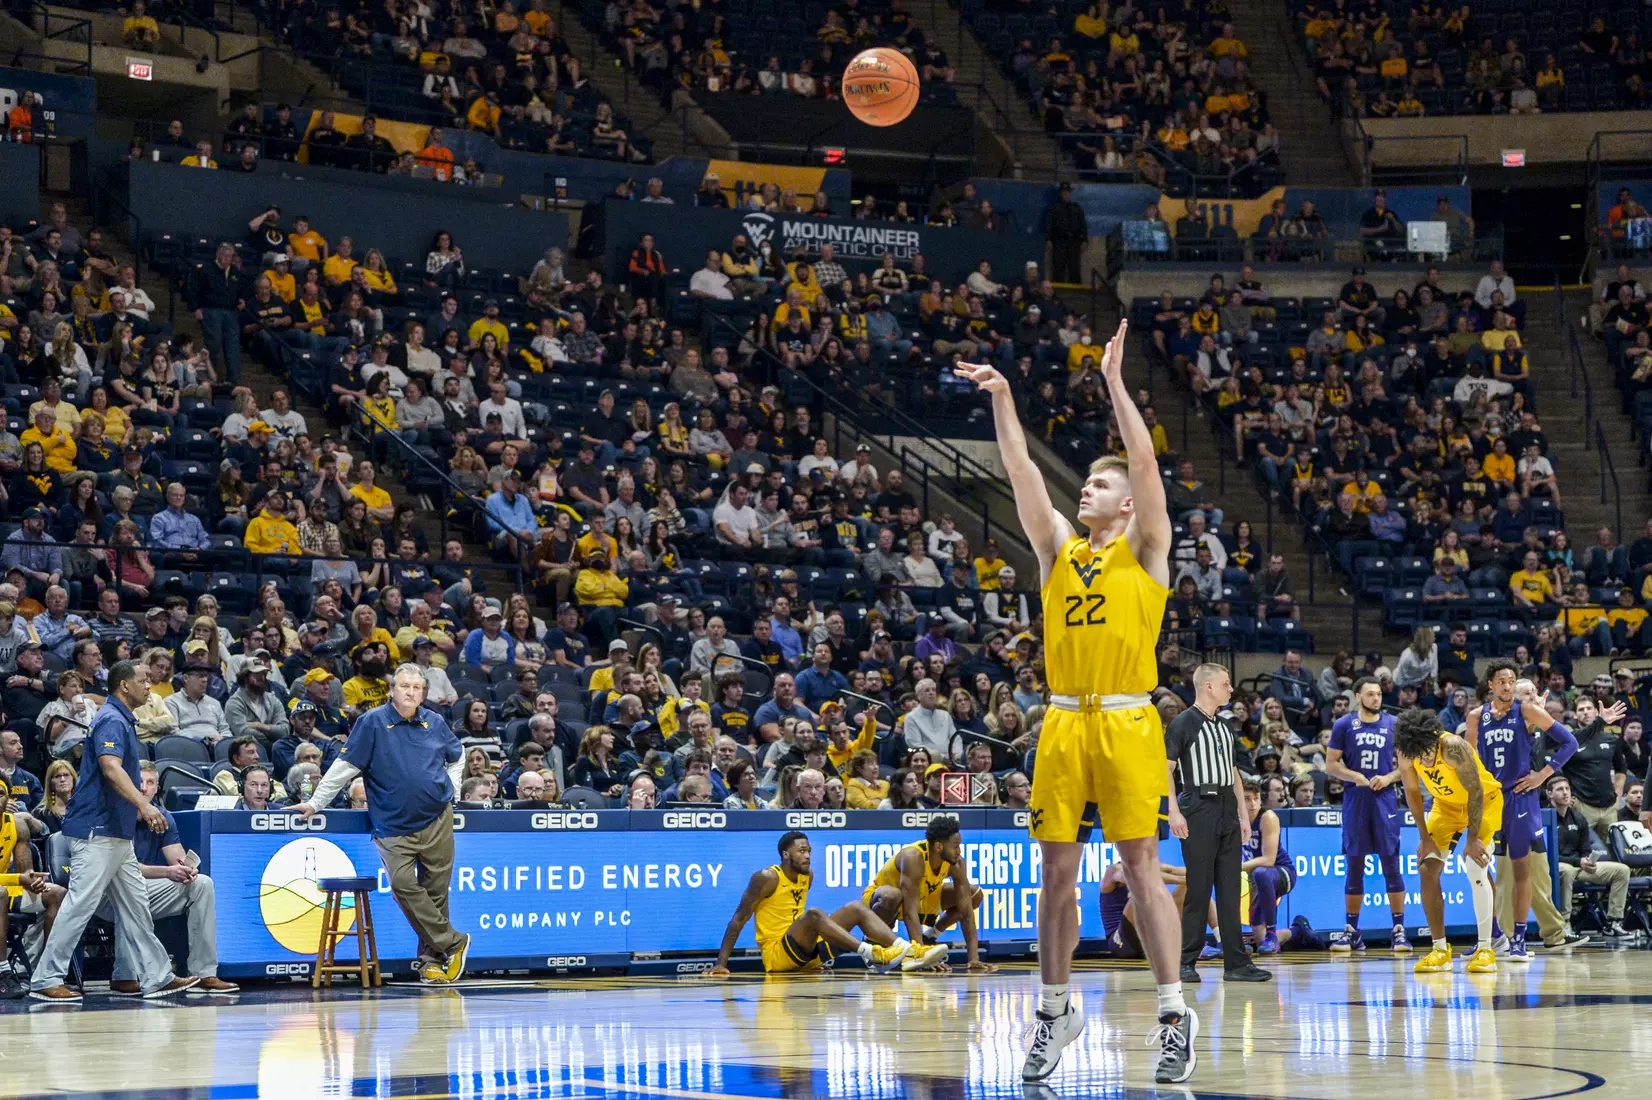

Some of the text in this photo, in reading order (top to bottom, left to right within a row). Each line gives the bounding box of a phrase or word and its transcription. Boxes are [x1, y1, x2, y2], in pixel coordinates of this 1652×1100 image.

[783, 220, 920, 247] MOUNTAINEER
[1065, 594, 1106, 627] 22
[1355, 732, 1386, 749] TCU
[1484, 728, 1514, 745] TCU
[1361, 750, 1379, 769] 21
[1494, 747, 1505, 768] 5
[251, 814, 327, 831] GEICO
[531, 813, 598, 829] GEICO
[663, 812, 727, 828] GEICO
[786, 812, 847, 828] GEICO
[602, 863, 723, 889] ENERGY
[479, 910, 632, 930] COMPANY PLC
[266, 964, 309, 975] GEICO
[547, 957, 586, 968] GEICO
[676, 963, 714, 973] GEICO
